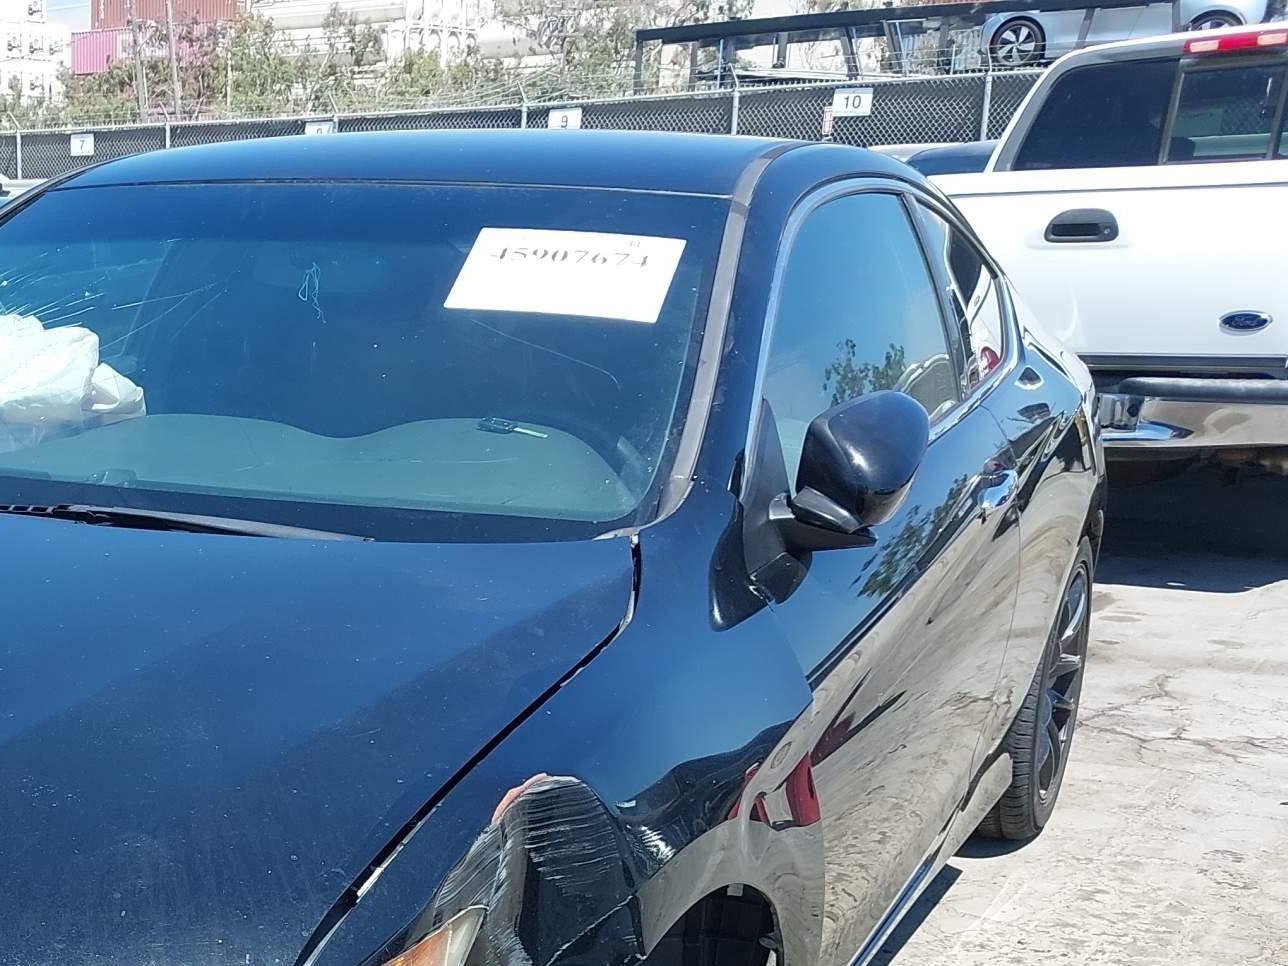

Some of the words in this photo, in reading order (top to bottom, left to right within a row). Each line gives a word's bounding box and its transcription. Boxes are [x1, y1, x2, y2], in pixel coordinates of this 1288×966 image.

[843, 94, 862, 109] 10
[560, 114, 569, 128] 9
[489, 246, 650, 268] 45907674
